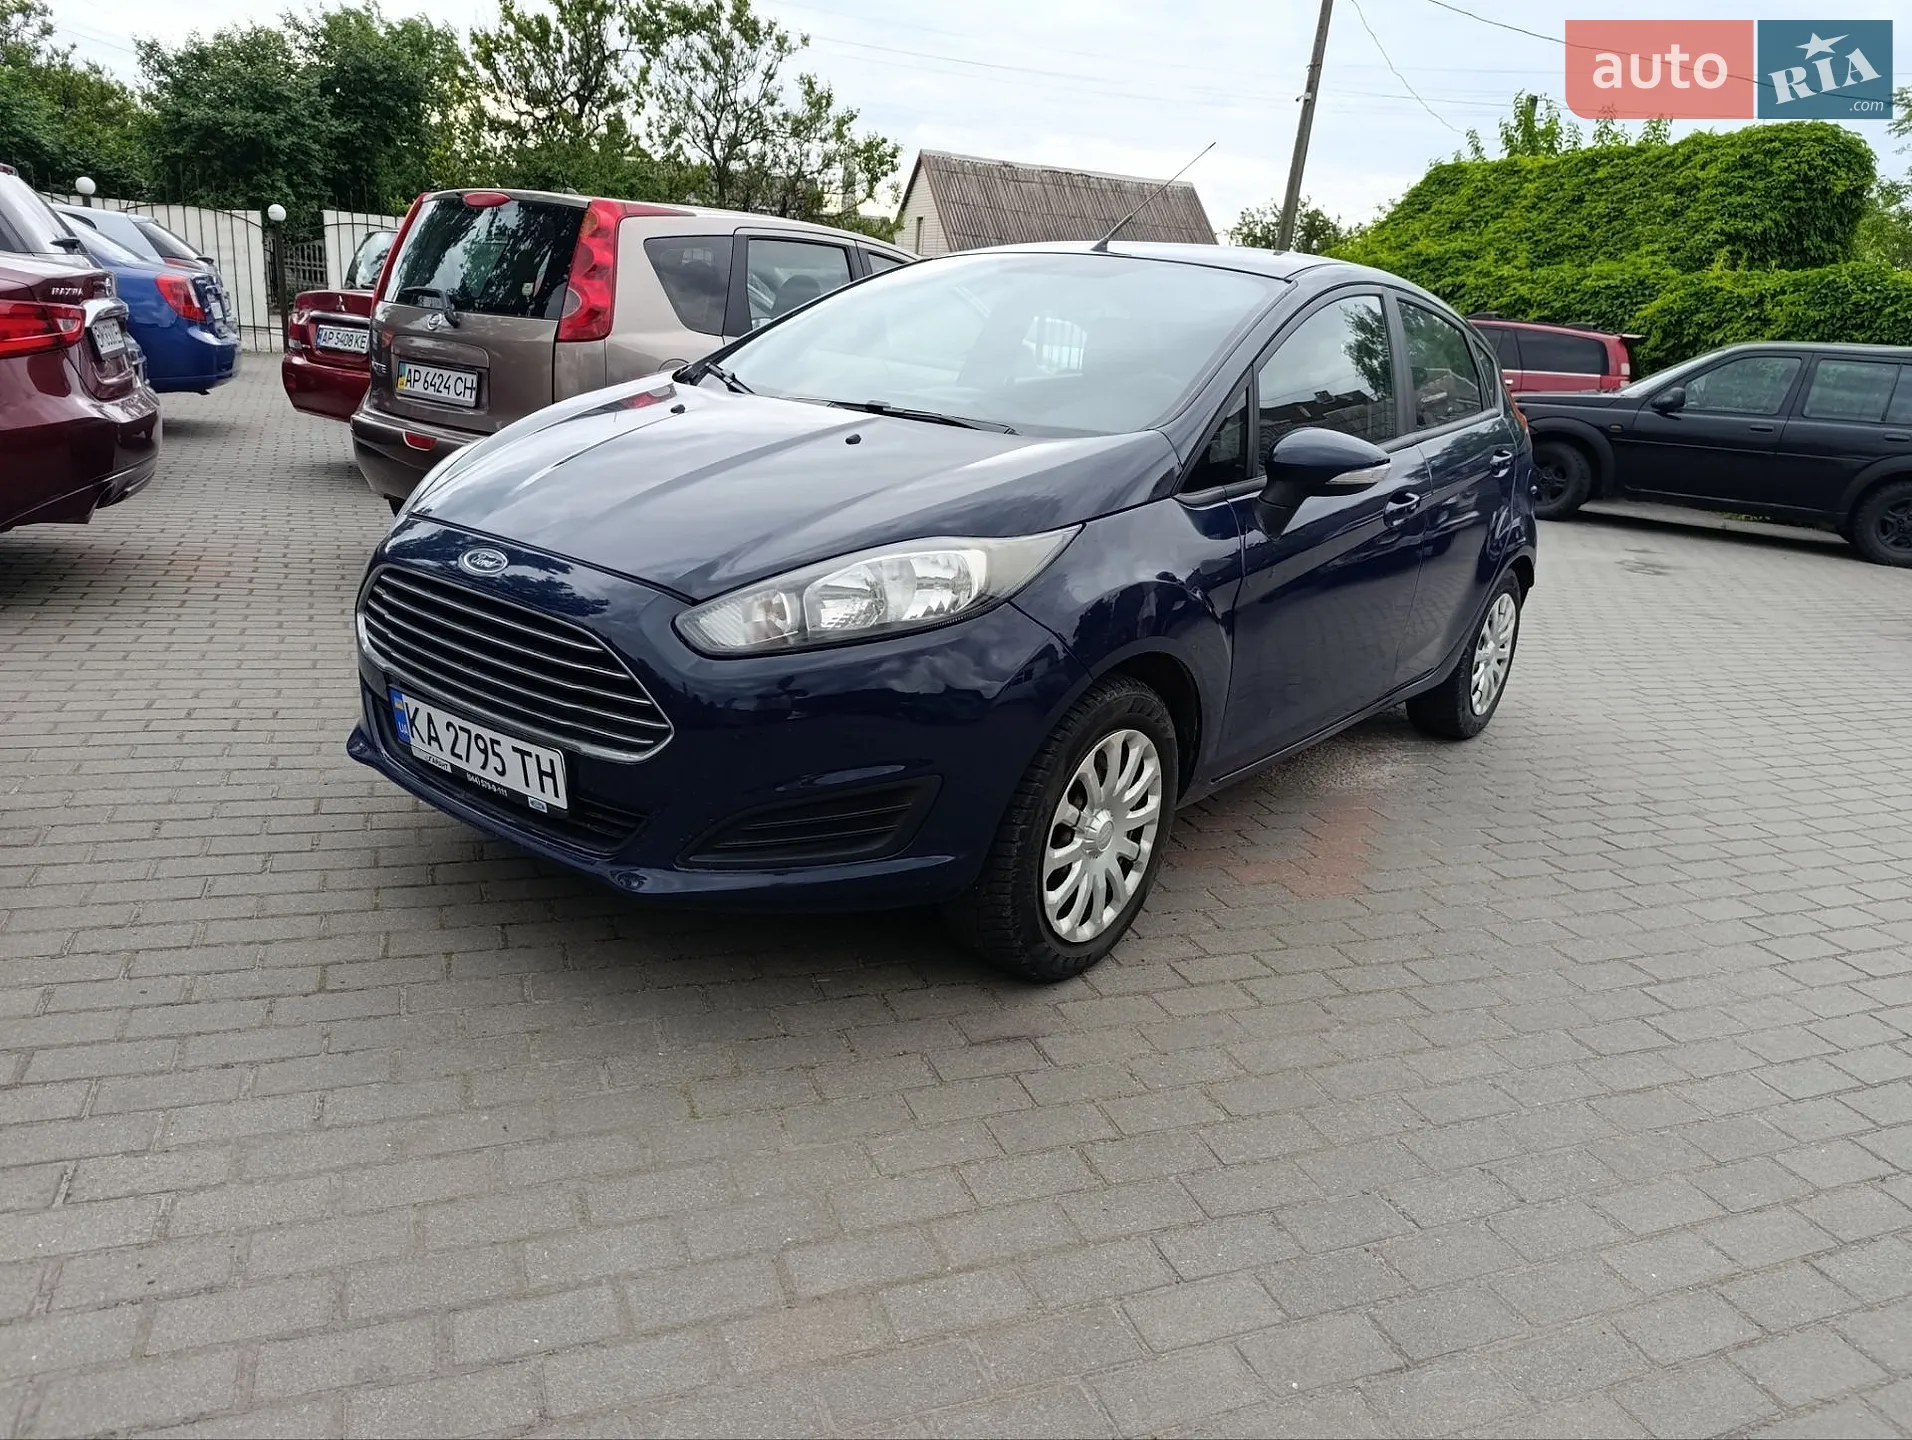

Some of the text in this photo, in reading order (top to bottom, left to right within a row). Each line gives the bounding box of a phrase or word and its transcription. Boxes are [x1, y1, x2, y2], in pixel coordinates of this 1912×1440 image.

[322, 330, 367, 349] AP 5408 KE
[405, 368, 475, 398] AP 6424 CH
[404, 701, 560, 799] KA 2795 TH
